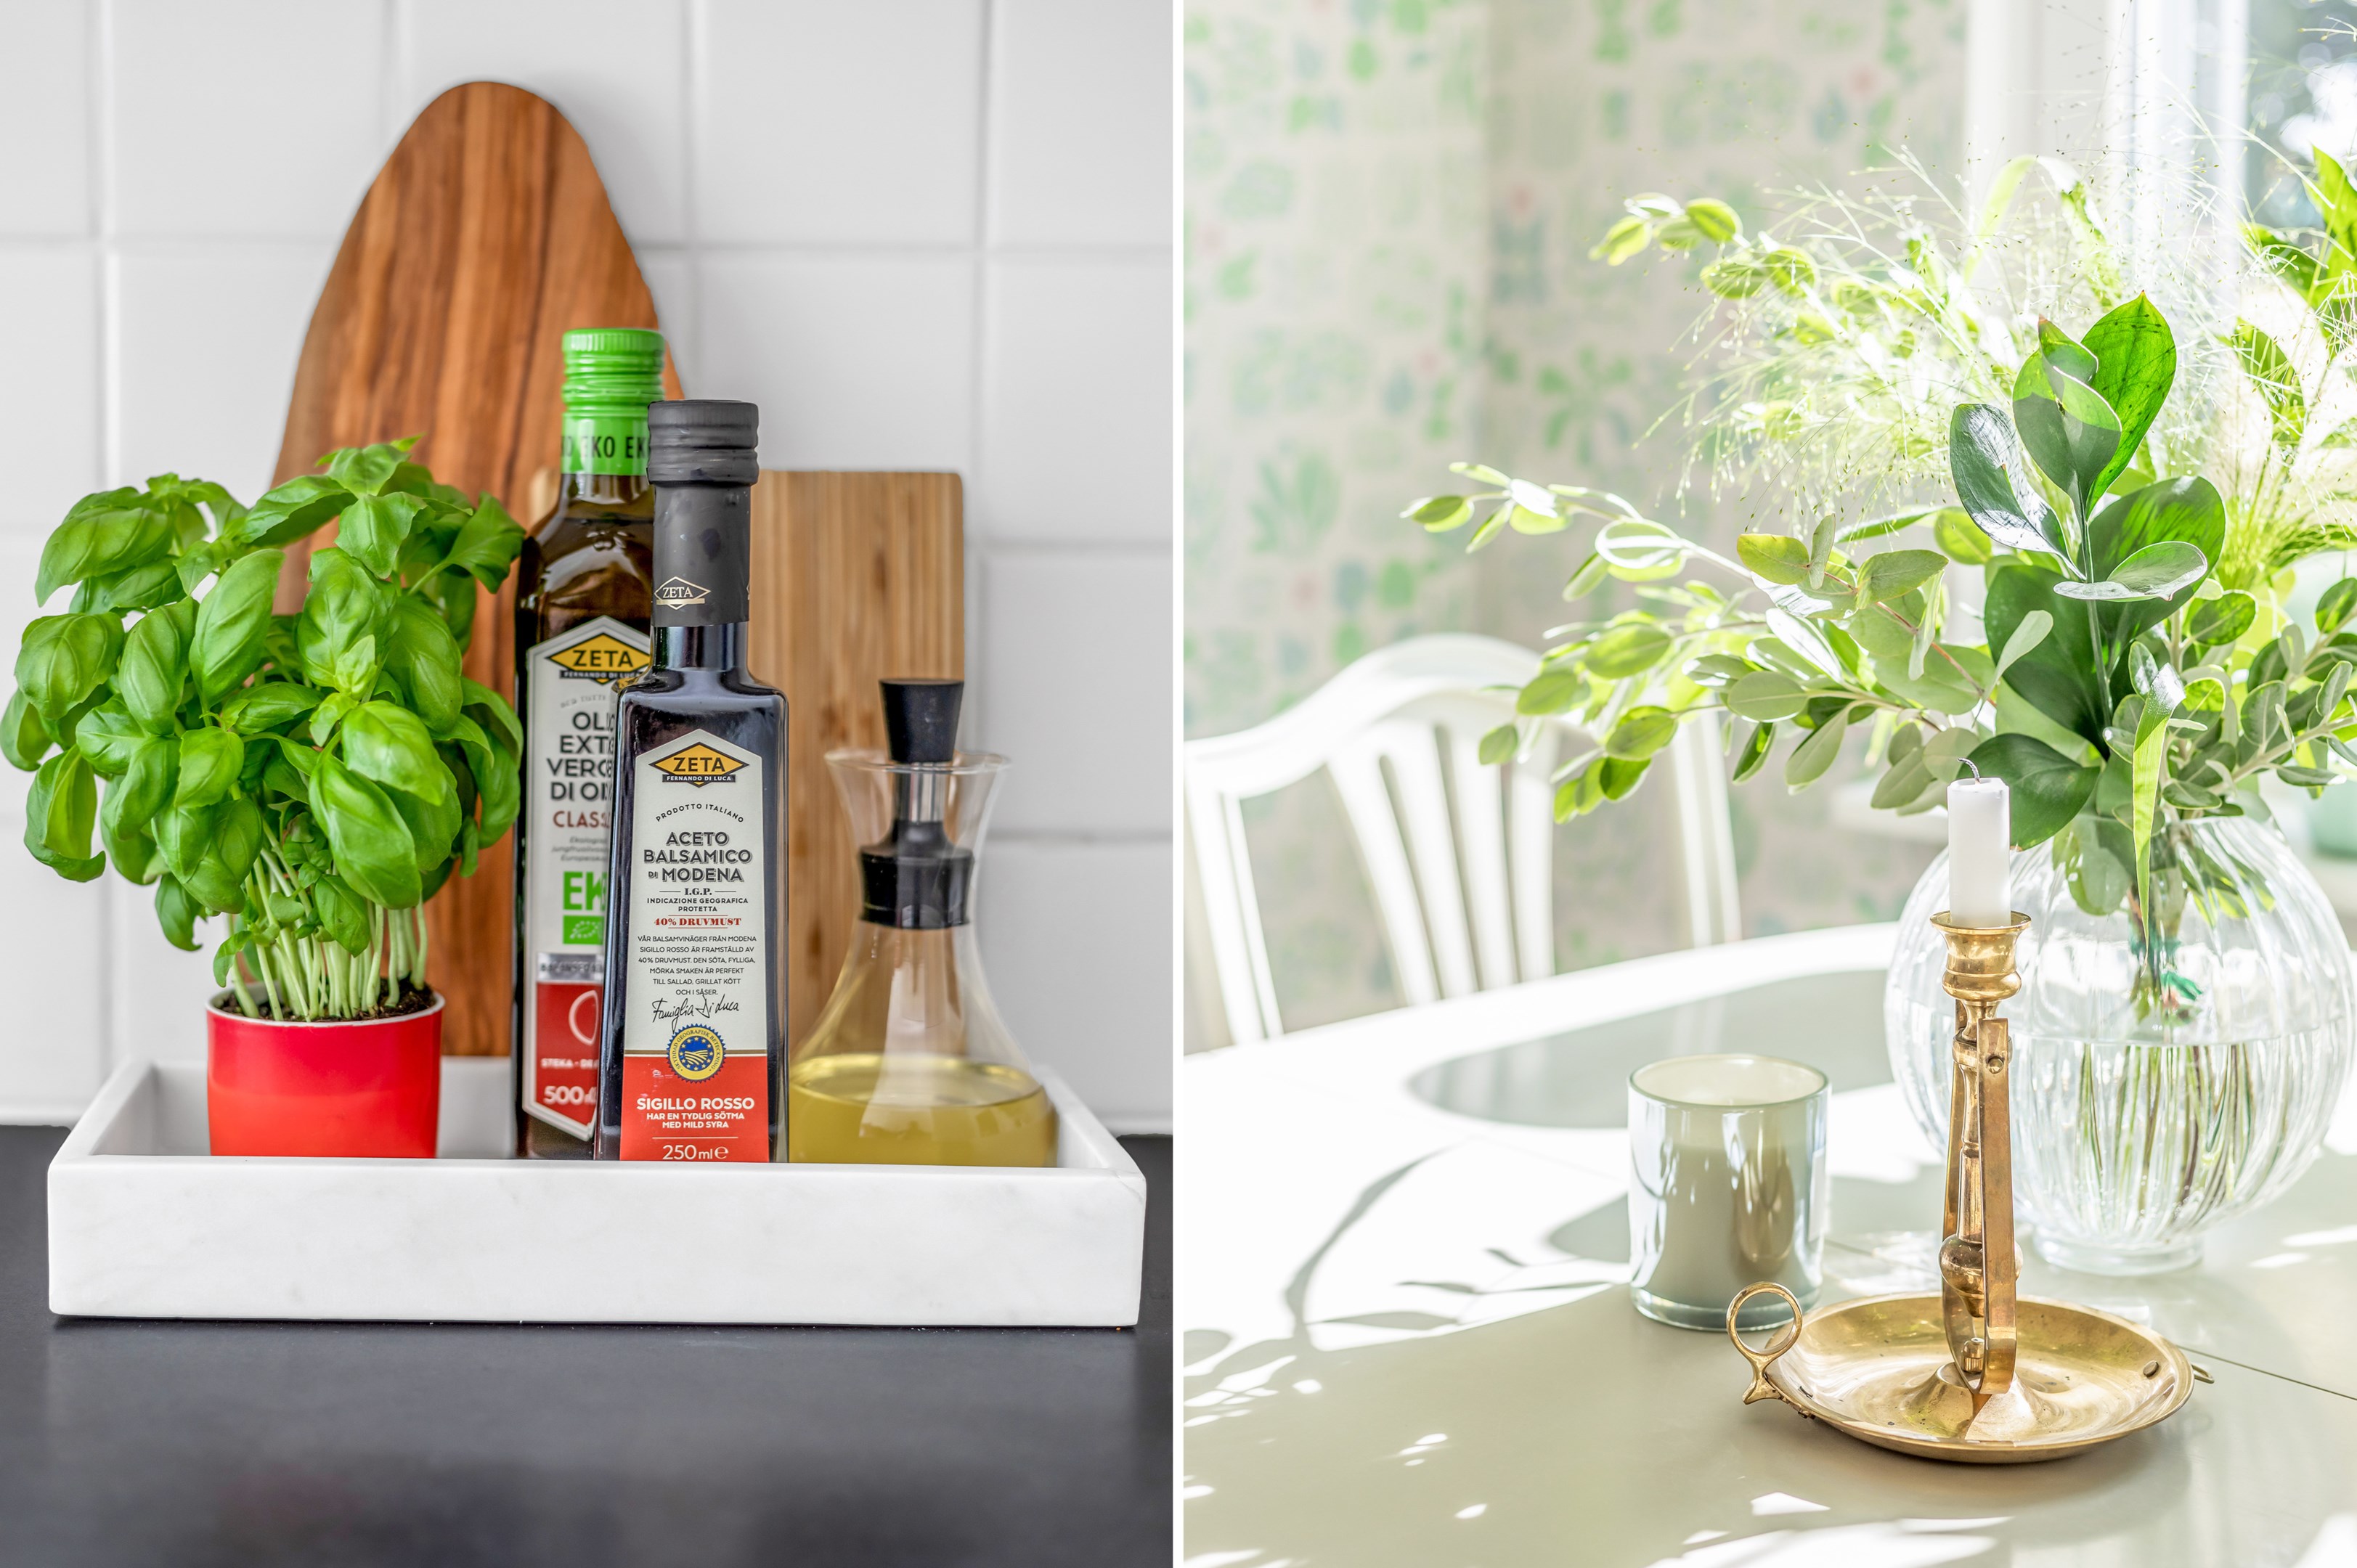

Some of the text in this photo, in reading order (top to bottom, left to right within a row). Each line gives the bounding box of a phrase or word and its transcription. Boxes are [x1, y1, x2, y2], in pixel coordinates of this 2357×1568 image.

[580, 436, 616, 459] EKO
[624, 436, 649, 459] EK
[662, 587, 693, 599] ZETA
[572, 650, 634, 668] ZETA
[673, 757, 725, 772] ZETA
[550, 782, 574, 801] DI
[656, 804, 744, 822] PRODOTTO ITALIANO
[666, 831, 729, 846] ACETO
[643, 849, 752, 864] BALSAMICO
[661, 867, 744, 883] MODENA
[563, 871, 607, 910] EK
[672, 1029, 720, 1070] SKYDDAD GEOGRAFISK BETECKNING
[637, 1097, 754, 1111] SIGILLO ROSSO
[714, 1111, 744, 1119] SÖTMA
